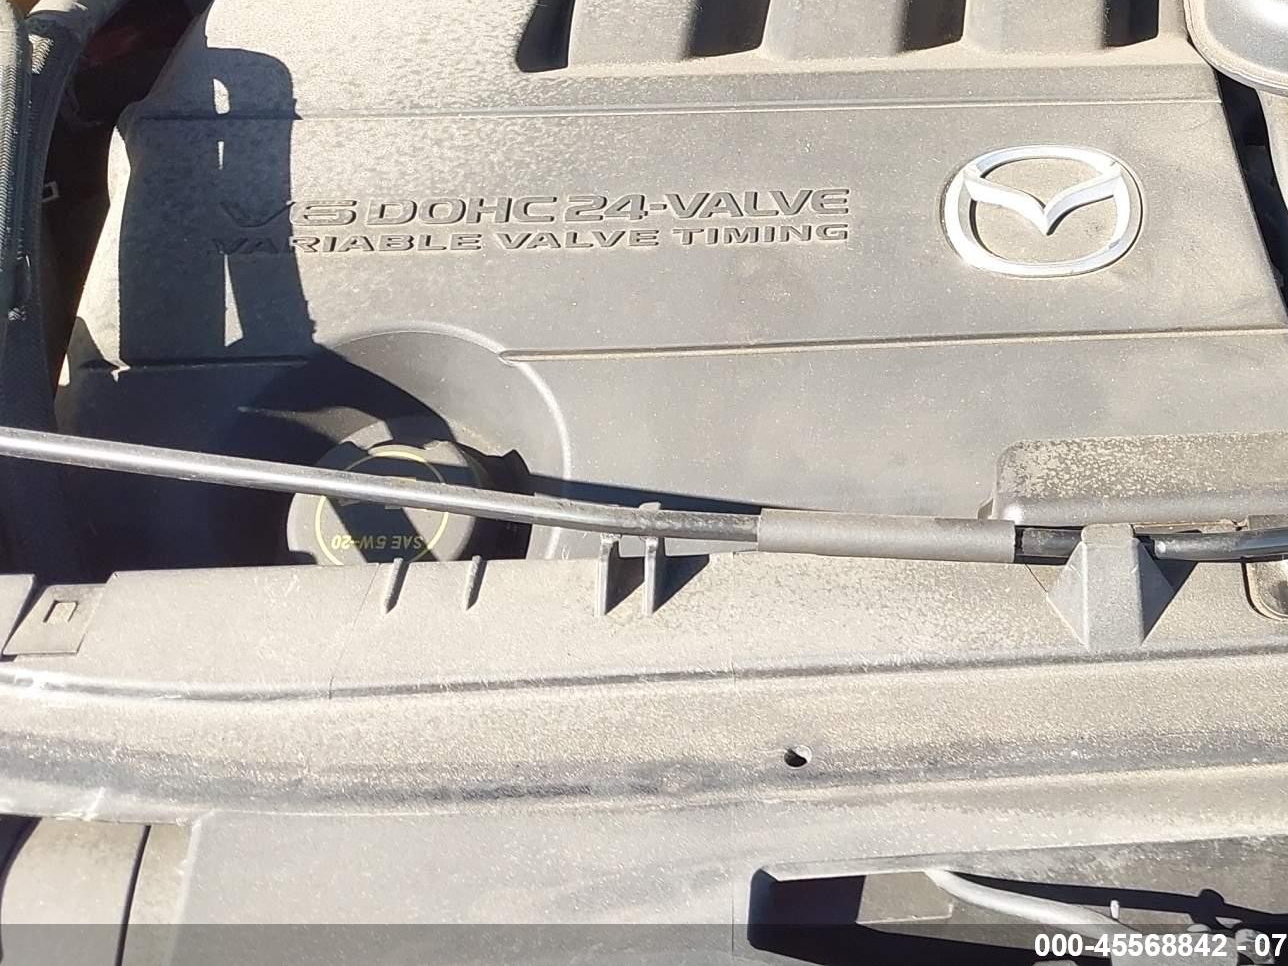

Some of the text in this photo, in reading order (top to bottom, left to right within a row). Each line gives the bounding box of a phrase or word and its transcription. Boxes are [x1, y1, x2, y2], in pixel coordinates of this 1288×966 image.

[219, 189, 850, 226] V6 DOHC 24-VALVE
[212, 223, 849, 255] VARIABLE VALVE TIMING
[332, 535, 422, 550] SAE 5W-20
